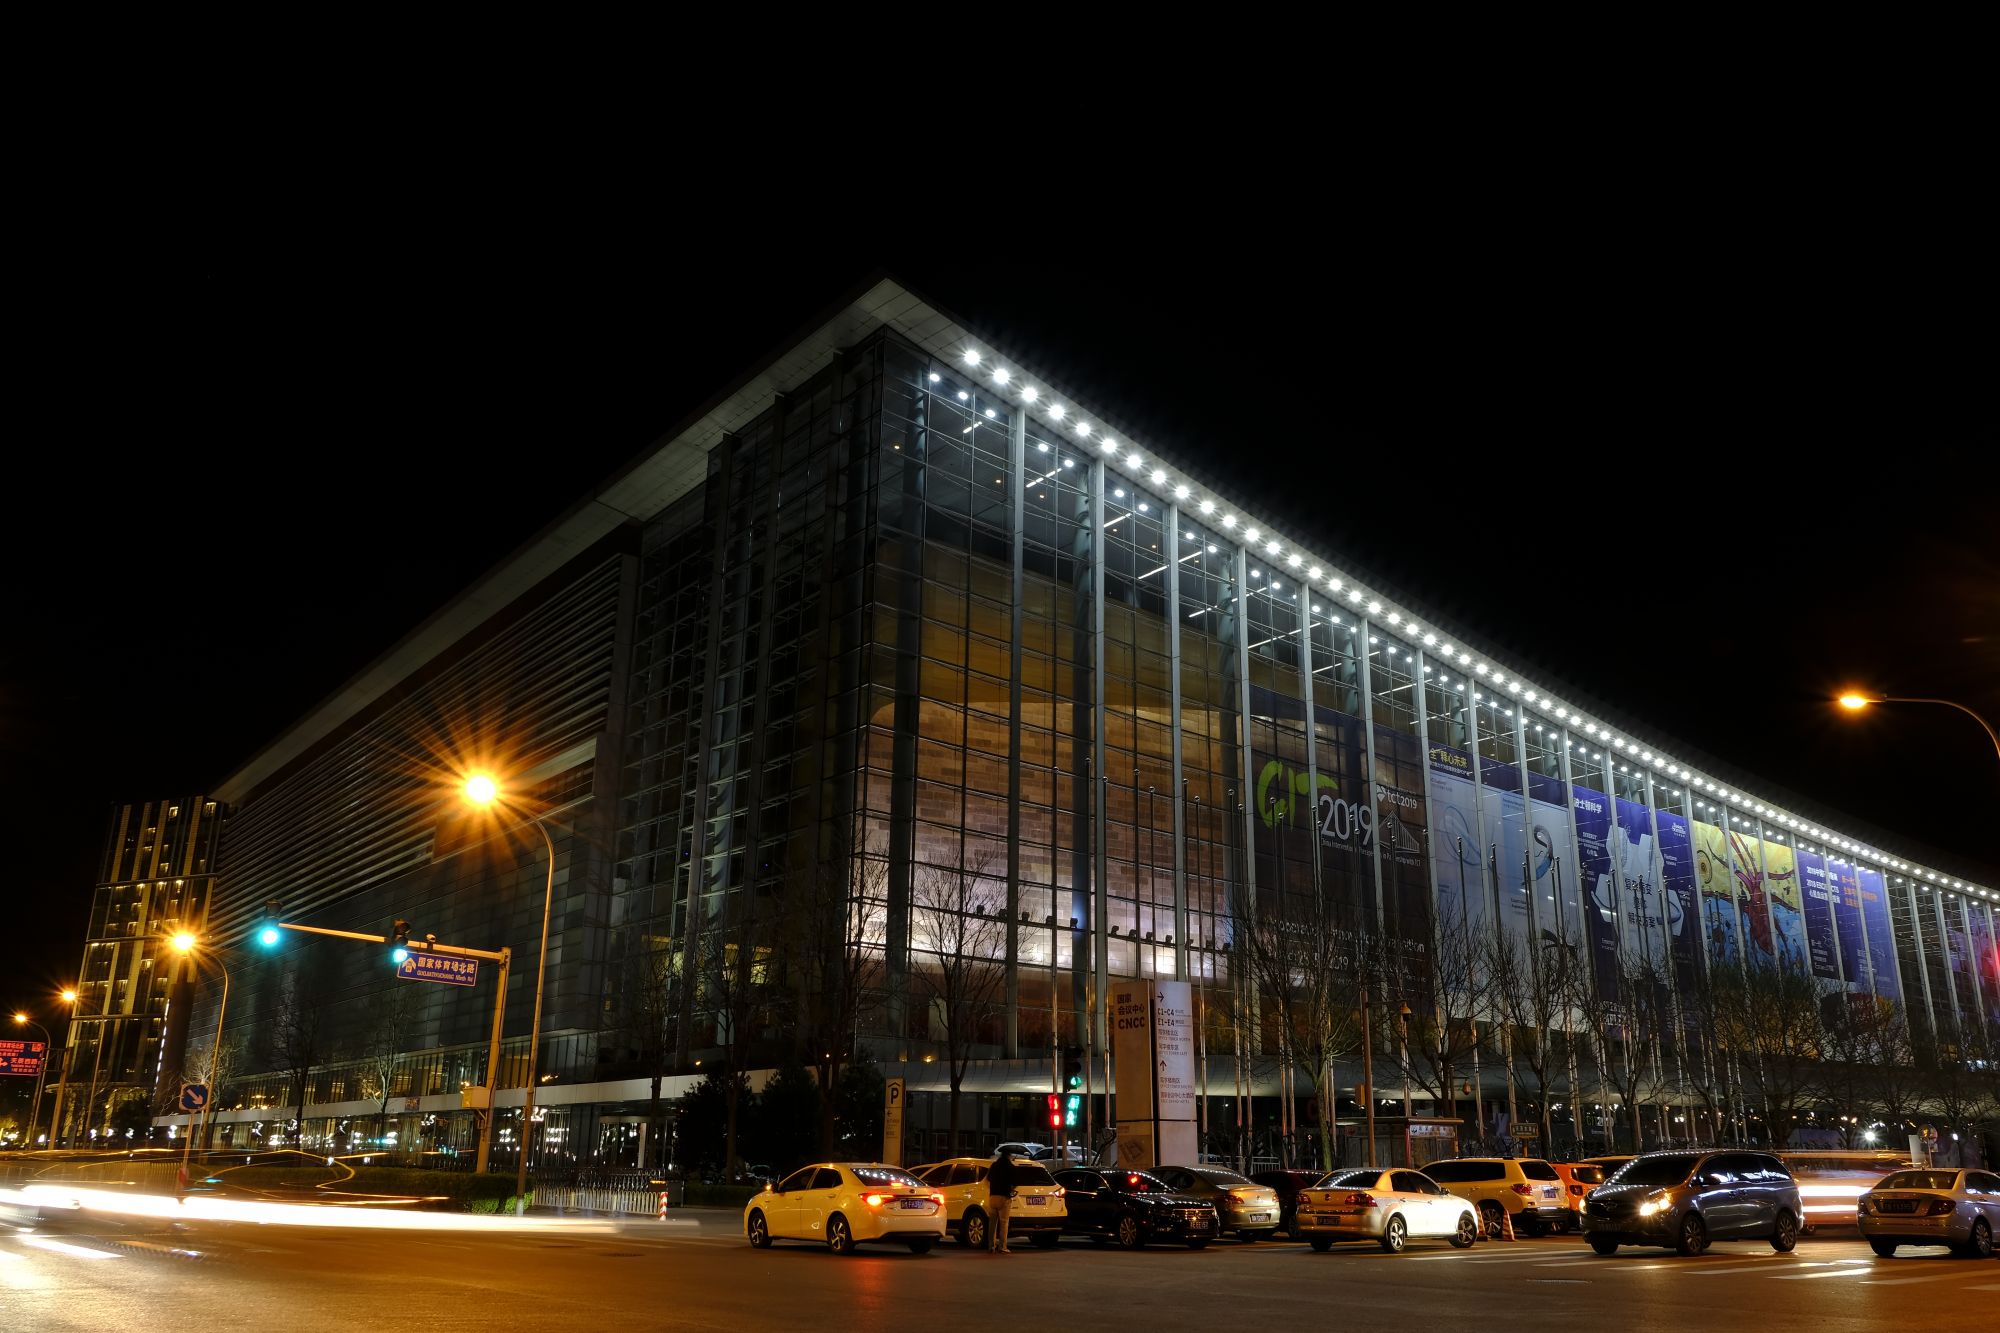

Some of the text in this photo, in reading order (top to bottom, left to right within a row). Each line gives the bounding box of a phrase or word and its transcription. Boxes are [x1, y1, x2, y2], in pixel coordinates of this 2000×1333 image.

[1319, 795, 1373, 846] 2019
[418, 957, 475, 974] 国家体育场北路
[1117, 993, 1131, 1003] 国家
[1118, 1004, 1145, 1015] 会议中心
[1157, 1008, 1174, 1016] C1-C4
[1118, 1017, 1145, 1029] CNCC
[1158, 1018, 1175, 1026] E1-E4
[891, 1088, 898, 1104] P
